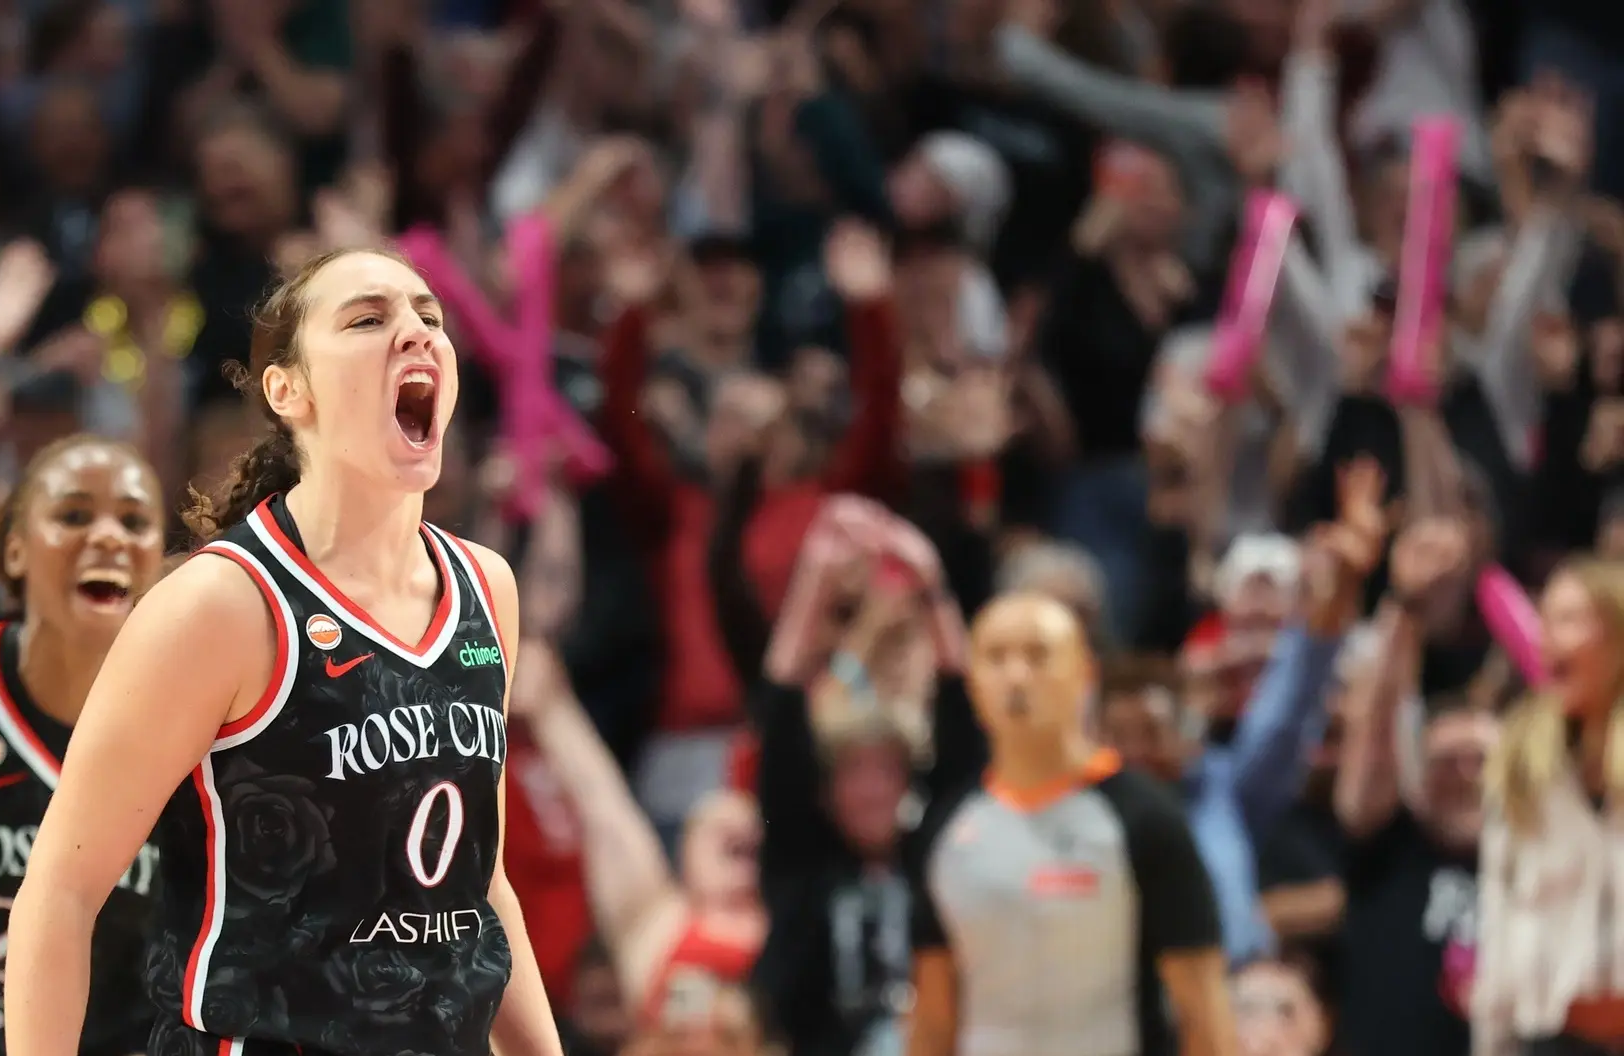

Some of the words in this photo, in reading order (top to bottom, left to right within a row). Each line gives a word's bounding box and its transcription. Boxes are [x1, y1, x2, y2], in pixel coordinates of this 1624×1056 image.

[459, 641, 501, 667] chime
[323, 704, 440, 781] ROSE
[406, 780, 464, 887] 0
